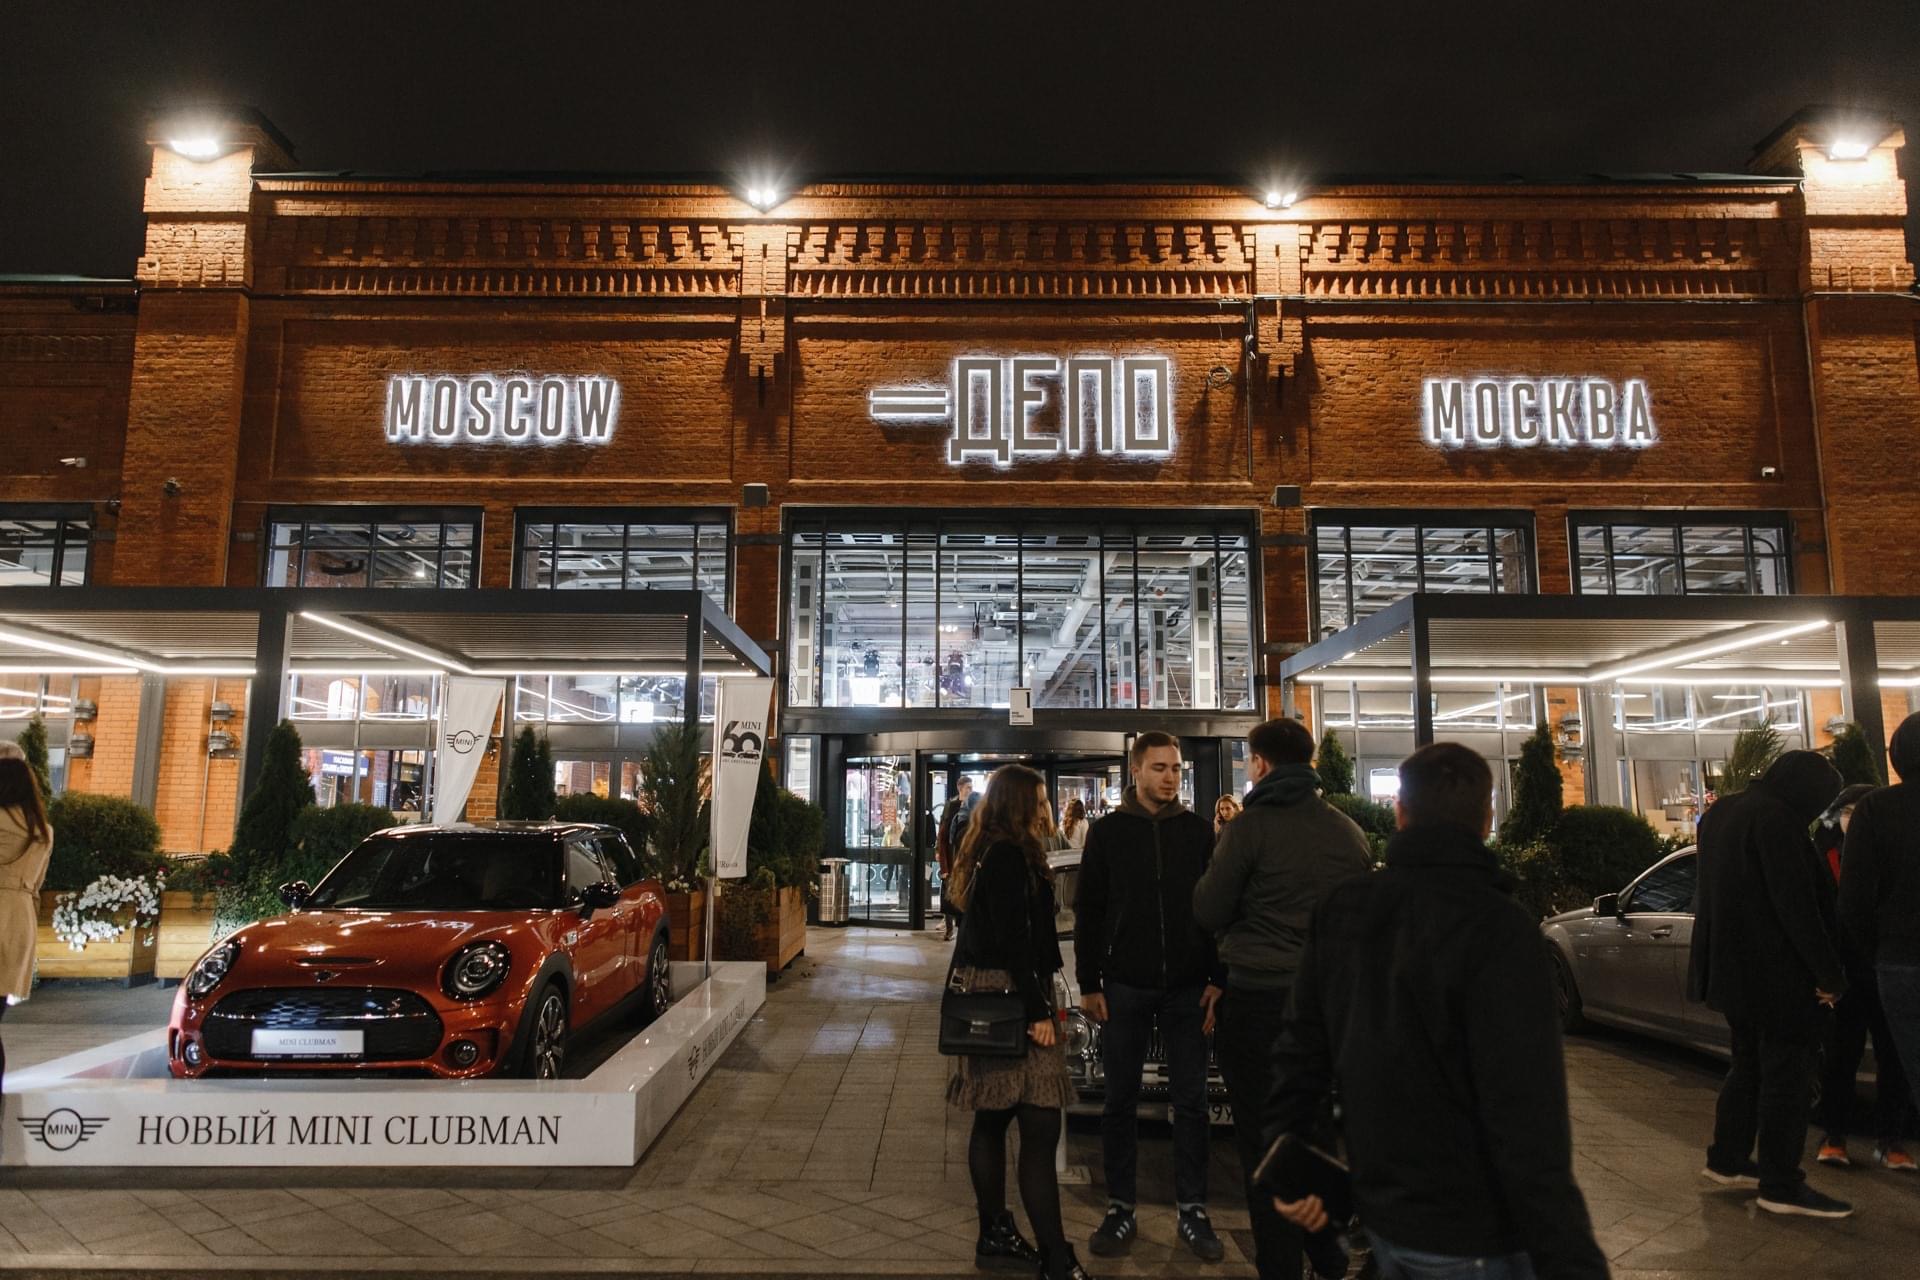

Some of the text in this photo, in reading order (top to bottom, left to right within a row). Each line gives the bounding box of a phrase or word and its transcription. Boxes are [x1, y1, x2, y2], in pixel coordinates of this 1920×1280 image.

[386, 377, 618, 439] MOSCOW
[949, 358, 1170, 463] ДЕПО
[1428, 381, 1653, 441] МОСКВА
[741, 721, 761, 730] MINI
[455, 738, 474, 746] MINI
[279, 1038, 337, 1046] MINI CLUBMAN
[47, 1123, 79, 1136] MINI
[137, 1108, 563, 1146] НОВЫЙ MINI CLUBMAN
